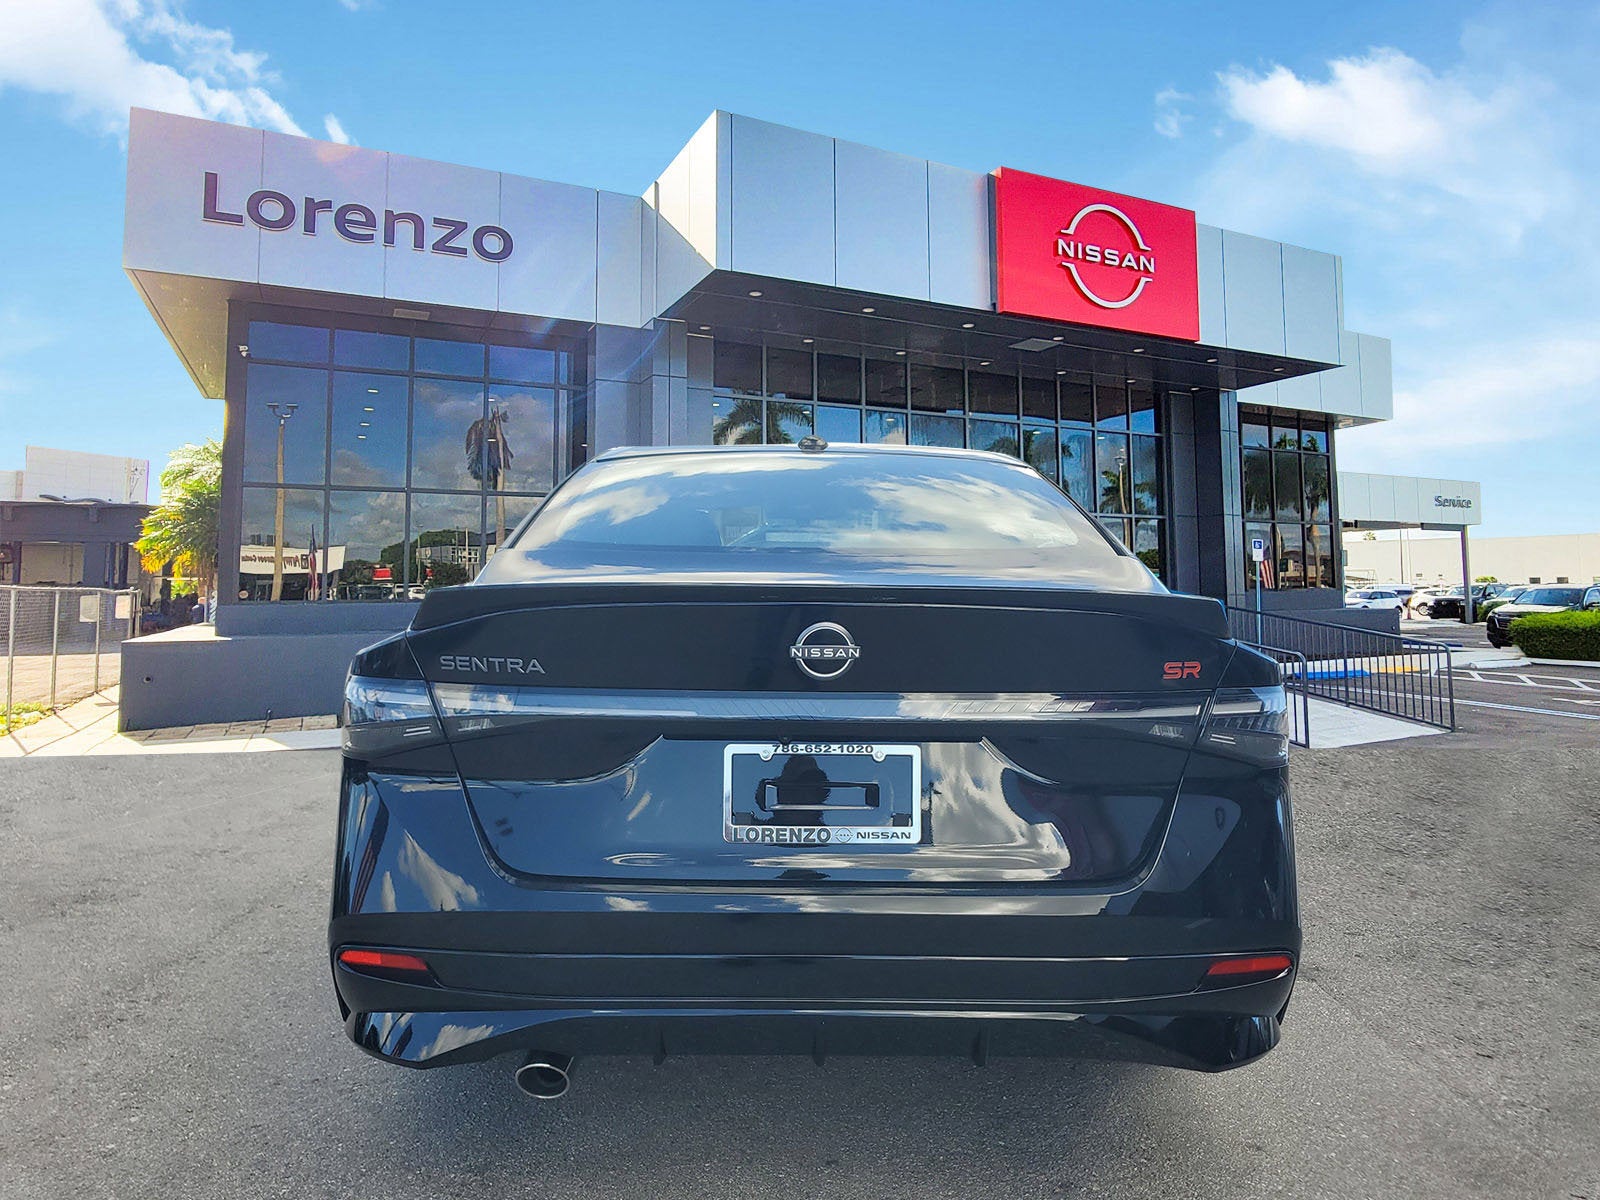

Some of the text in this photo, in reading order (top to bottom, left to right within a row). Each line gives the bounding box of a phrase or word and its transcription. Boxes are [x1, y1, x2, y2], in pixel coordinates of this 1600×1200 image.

[202, 170, 515, 263] Lorenzo
[1057, 238, 1155, 273] NISSAN
[1434, 495, 1472, 509] Service
[791, 648, 860, 658] NISSAN
[440, 655, 546, 674] SENTRA
[1163, 661, 1202, 679] SR
[771, 744, 874, 754] 786-652-1020
[733, 827, 912, 843] LORENZO NISSAN
